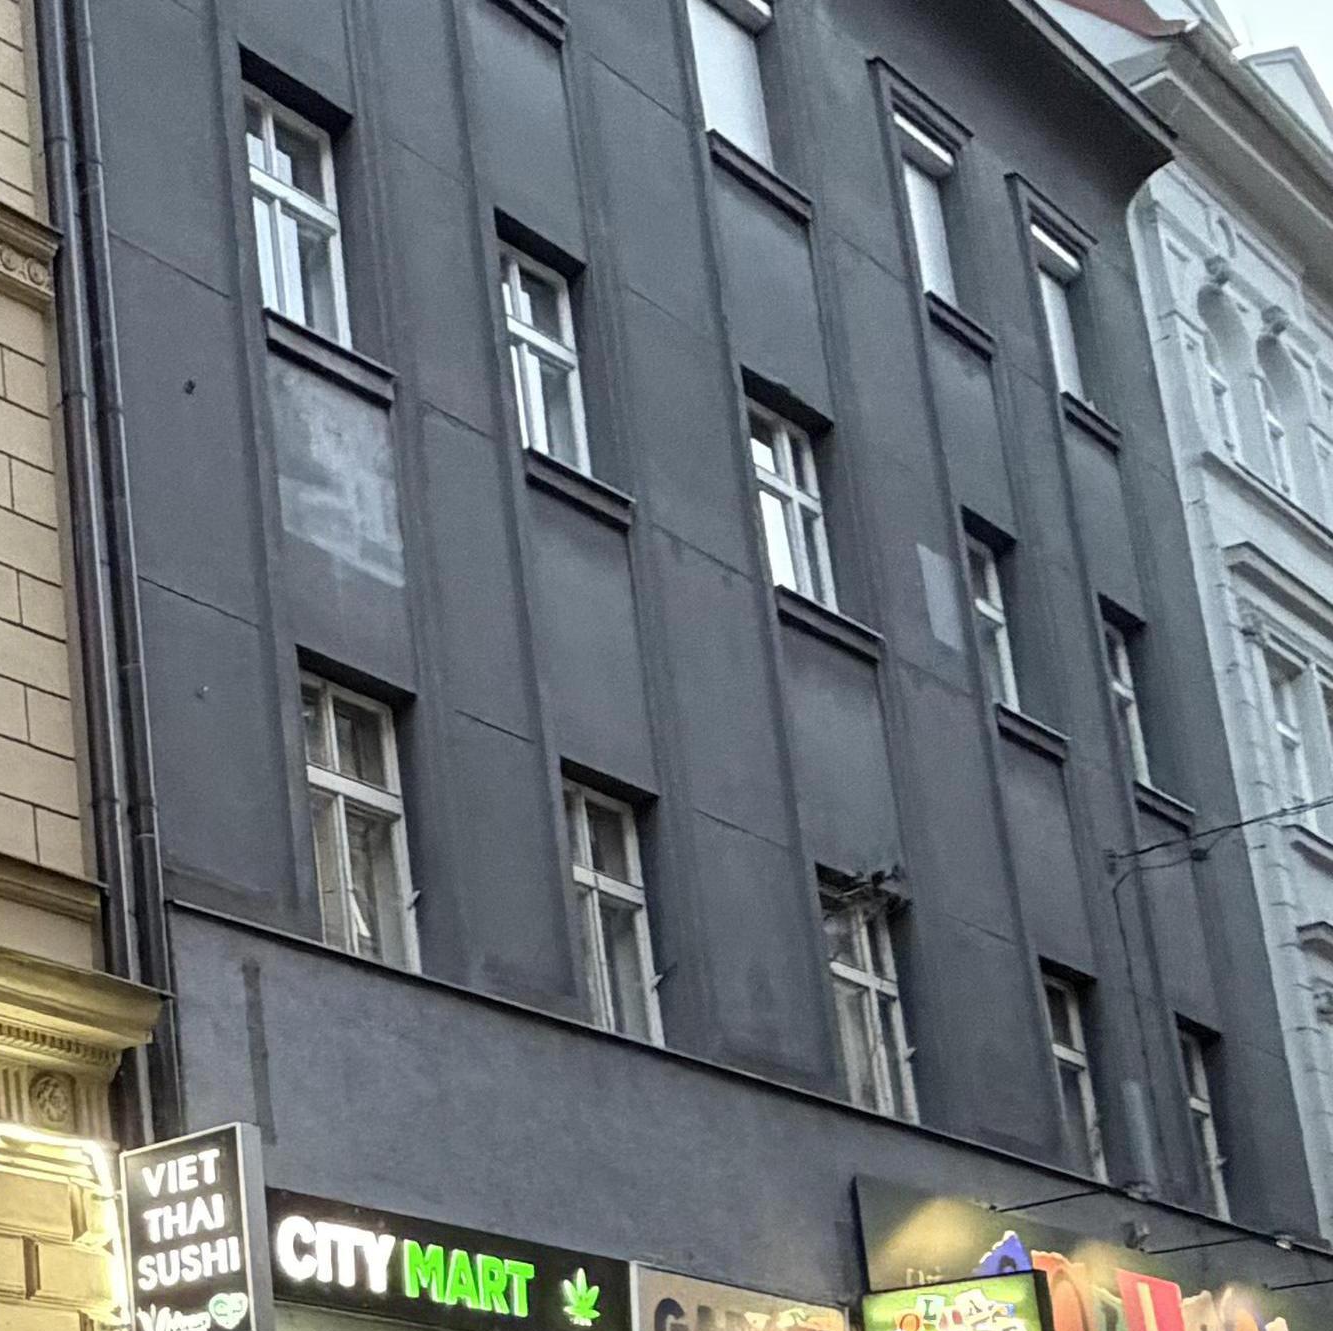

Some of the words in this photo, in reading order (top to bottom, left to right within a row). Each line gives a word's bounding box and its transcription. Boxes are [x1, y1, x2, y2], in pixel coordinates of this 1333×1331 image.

[142, 1148, 221, 1198] VIET
[143, 1193, 225, 1244] THAI
[137, 1236, 241, 1291] SUSHI
[276, 1215, 395, 1294] CITY
[403, 1238, 534, 1318] MART
